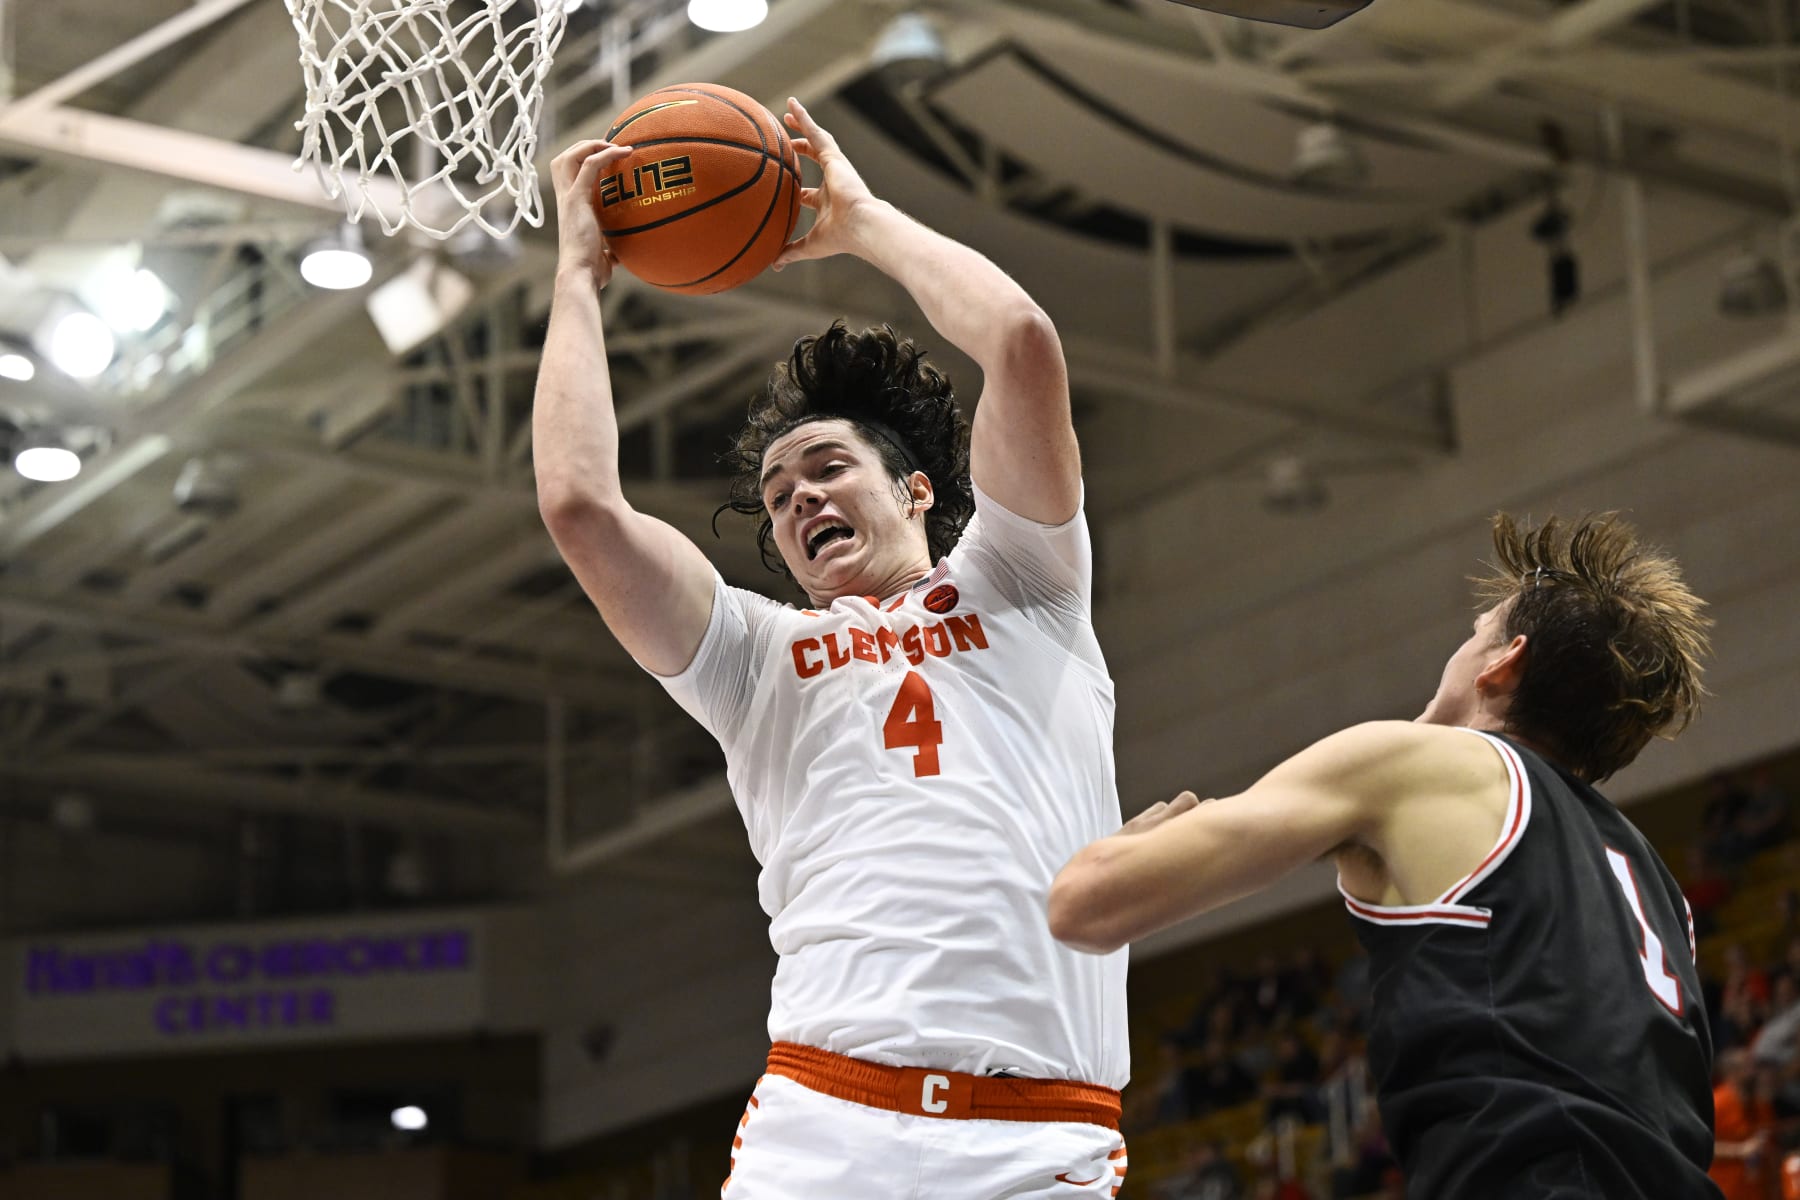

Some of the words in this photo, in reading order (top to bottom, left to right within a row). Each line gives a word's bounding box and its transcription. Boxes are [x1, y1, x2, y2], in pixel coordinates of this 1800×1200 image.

[600, 155, 694, 208] ELITE
[791, 613, 989, 679] CLEMSON
[883, 670, 943, 778] 4
[154, 989, 335, 1034] CENTER
[921, 1074, 950, 1114] C
